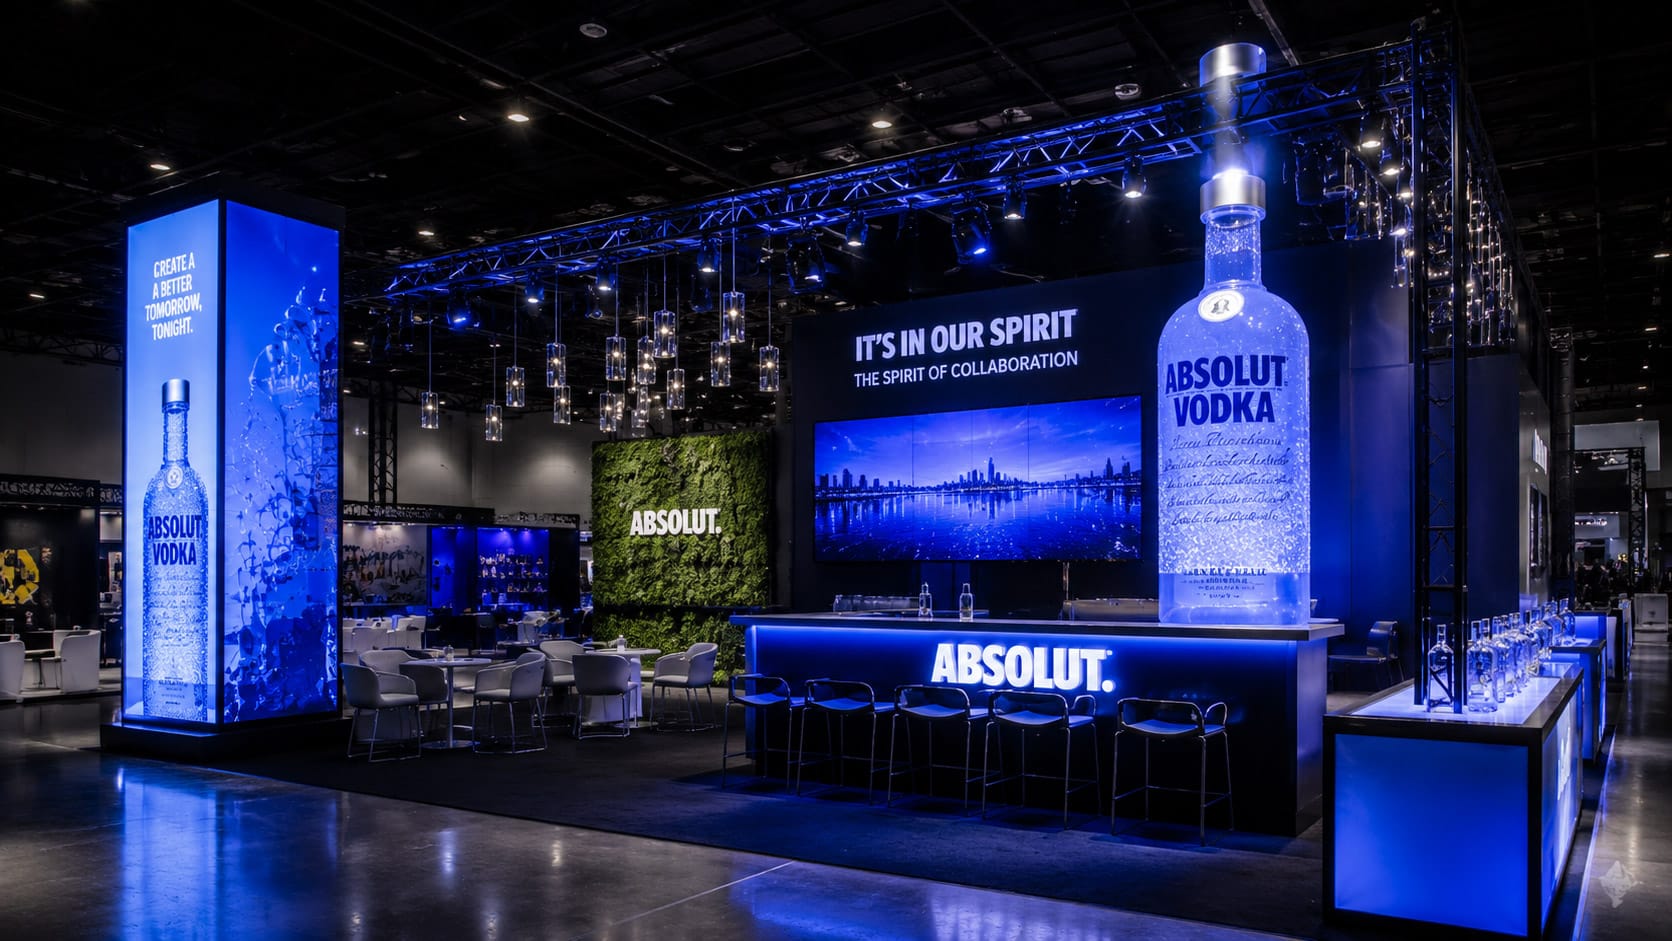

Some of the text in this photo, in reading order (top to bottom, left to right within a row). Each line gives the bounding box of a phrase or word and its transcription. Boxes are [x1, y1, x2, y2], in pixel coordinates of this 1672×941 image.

[154, 252, 196, 278] CREATE A
[152, 274, 193, 300] A BETTER
[145, 293, 202, 321] TOMORROW,
[152, 317, 193, 340] TONIGHT.
[856, 309, 1078, 362] IT’S IN OUR SPIRIT
[854, 350, 1078, 388] THE SPIRIT OF COLLABORATION
[1174, 391, 1275, 427] VODKA
[630, 508, 722, 536] ABSOLUT.
[153, 542, 197, 566] VODKA
[931, 643, 1115, 693] ABSOLUT.
